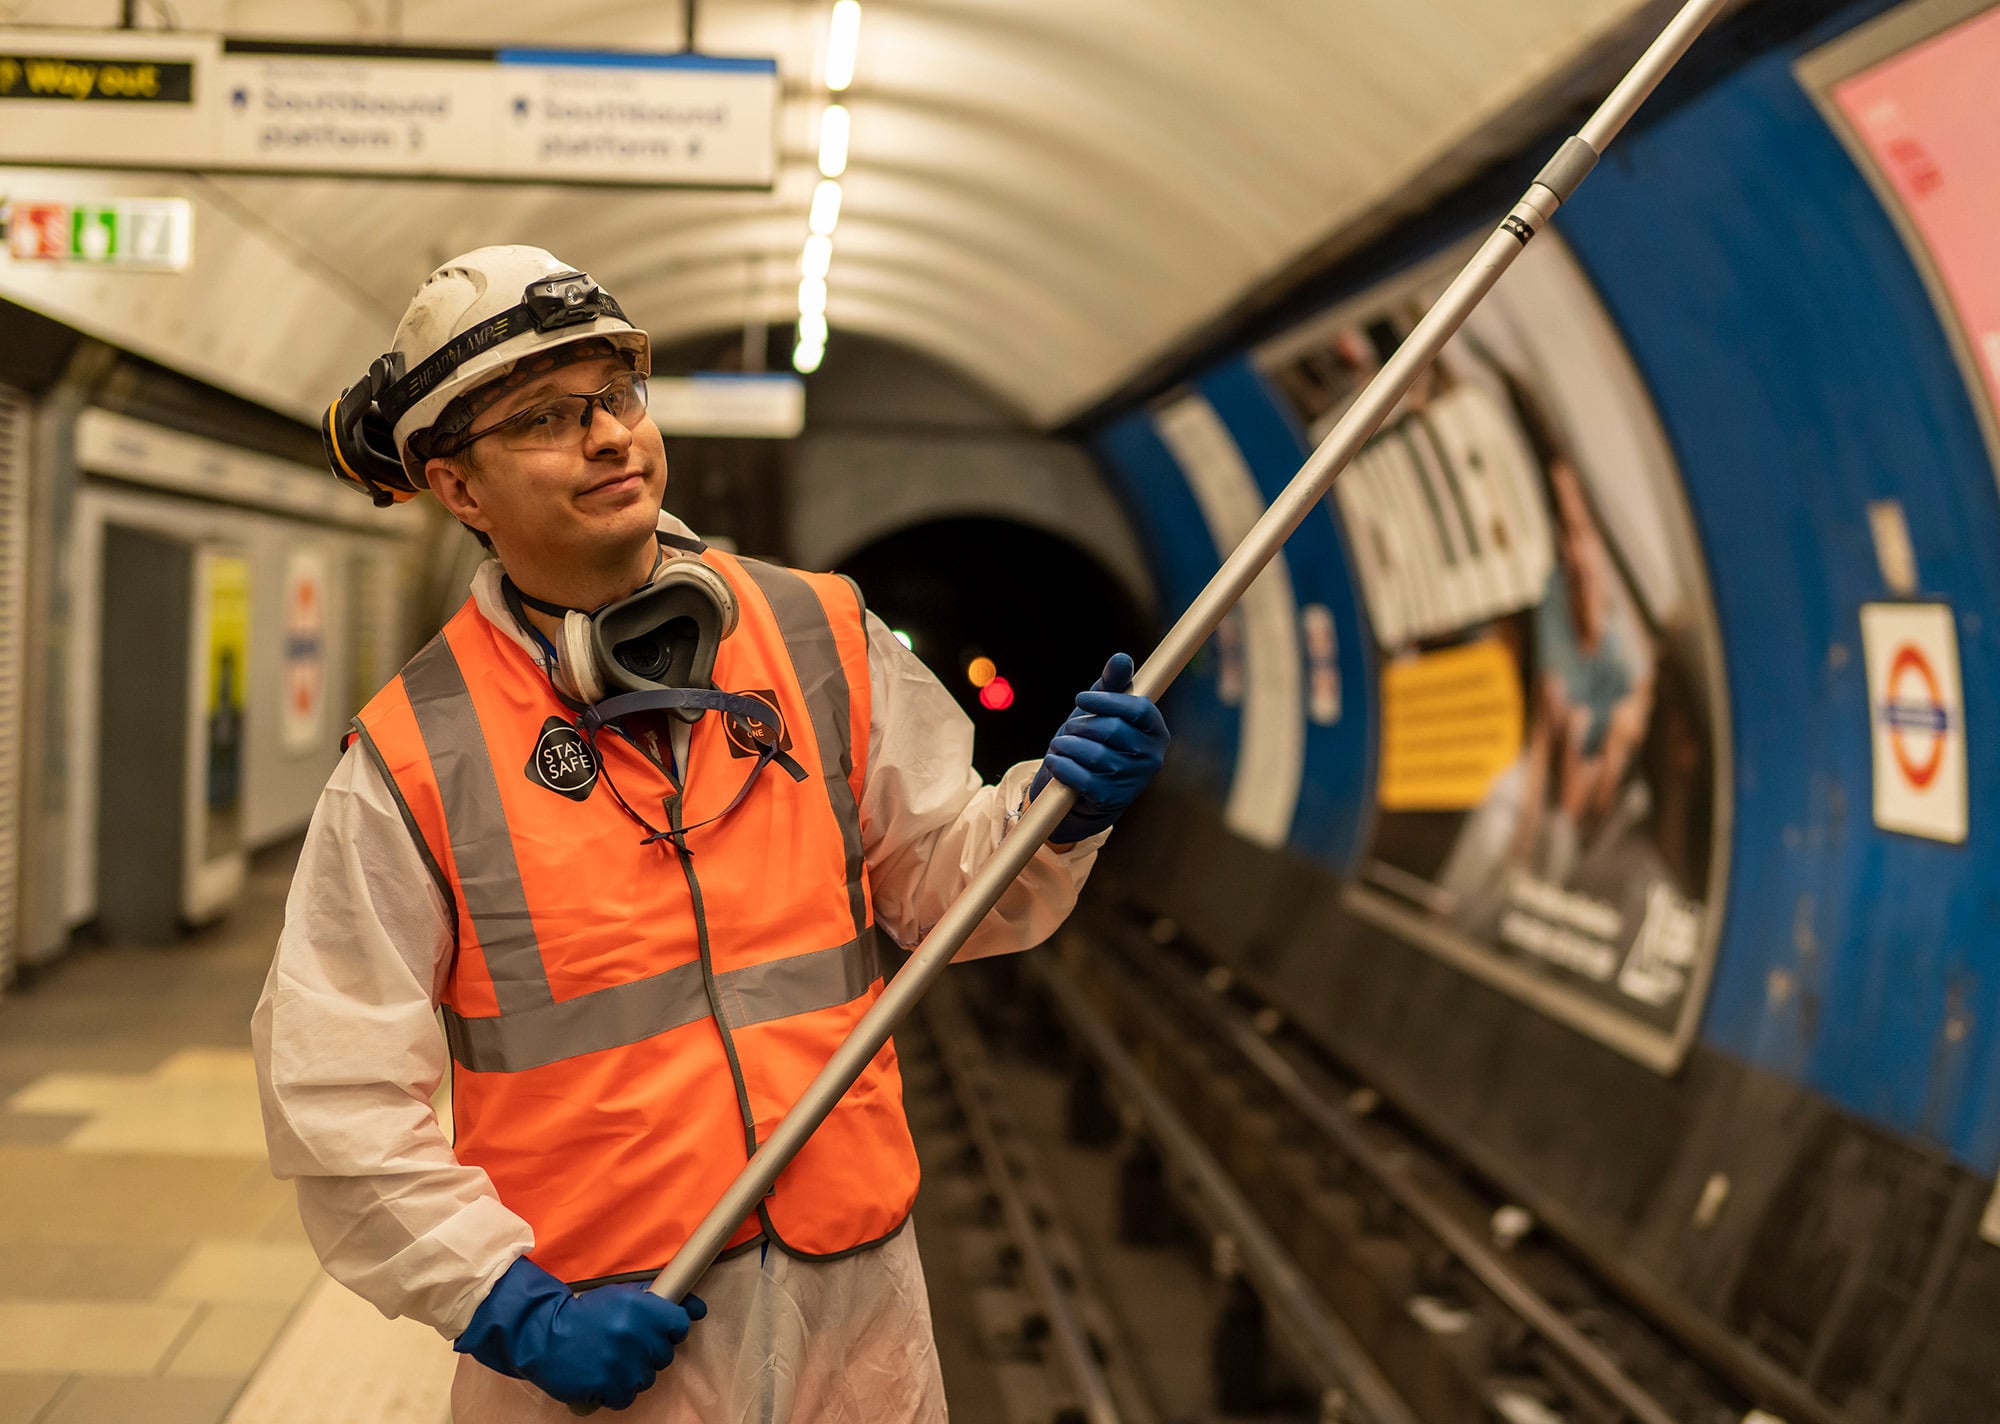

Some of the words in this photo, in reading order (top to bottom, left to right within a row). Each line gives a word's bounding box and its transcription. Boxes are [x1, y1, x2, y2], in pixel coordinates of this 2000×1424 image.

[25, 61, 96, 100] Way
[98, 65, 160, 97] out
[543, 740, 583, 764] STAY
[548, 754, 591, 779] SAFE
